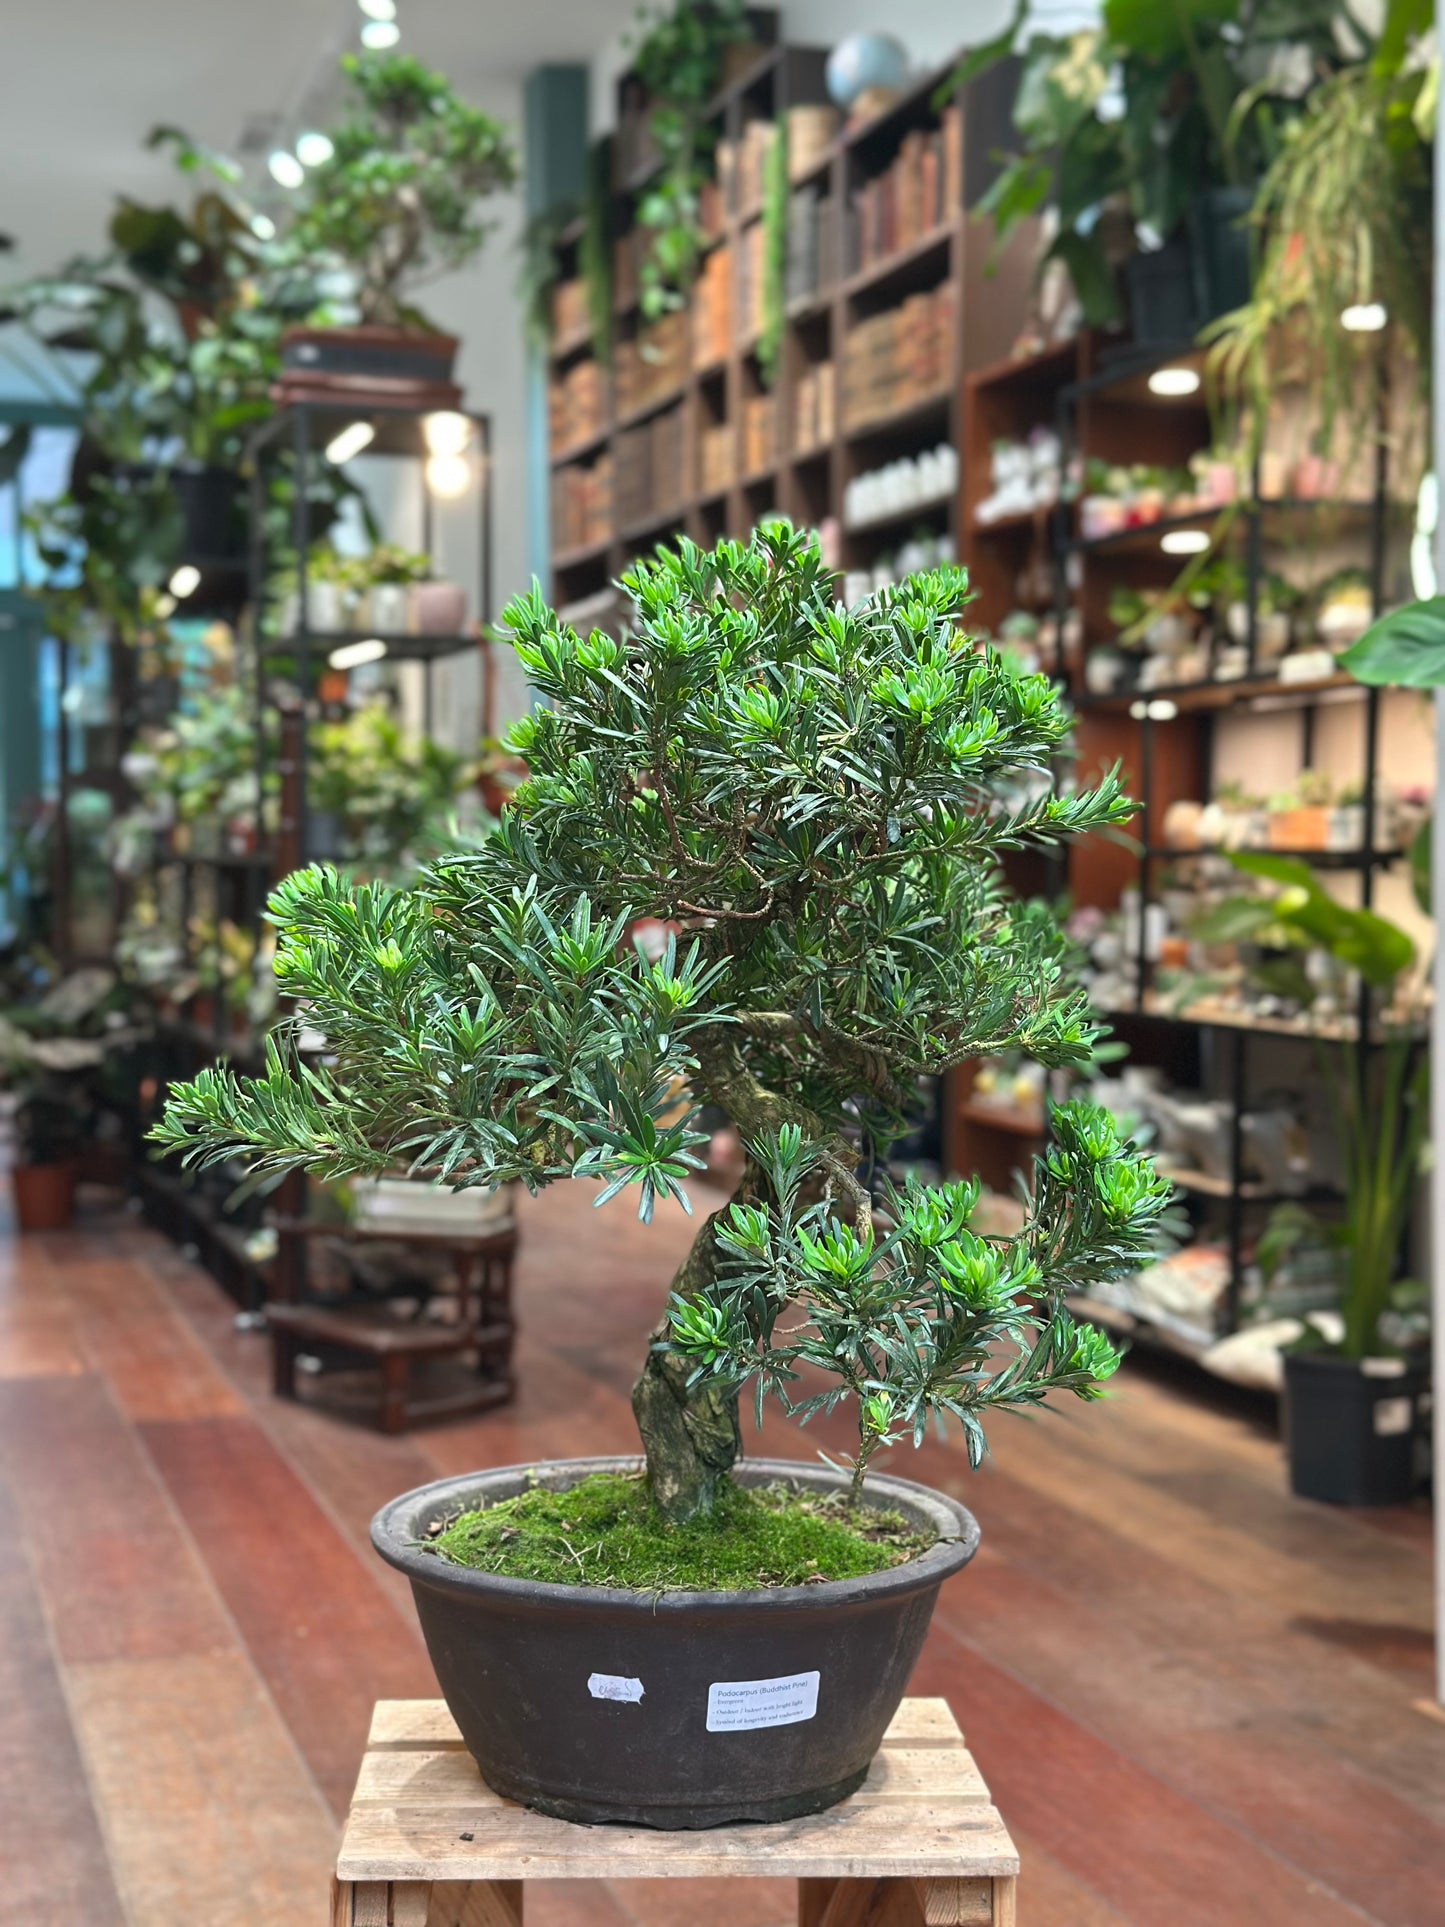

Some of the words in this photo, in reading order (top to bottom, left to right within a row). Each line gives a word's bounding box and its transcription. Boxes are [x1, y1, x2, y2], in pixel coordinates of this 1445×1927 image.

[718, 1689, 758, 1698] Podocarpus
[759, 1684, 791, 1695] (Buddhist
[792, 1680, 808, 1689] Pine)
